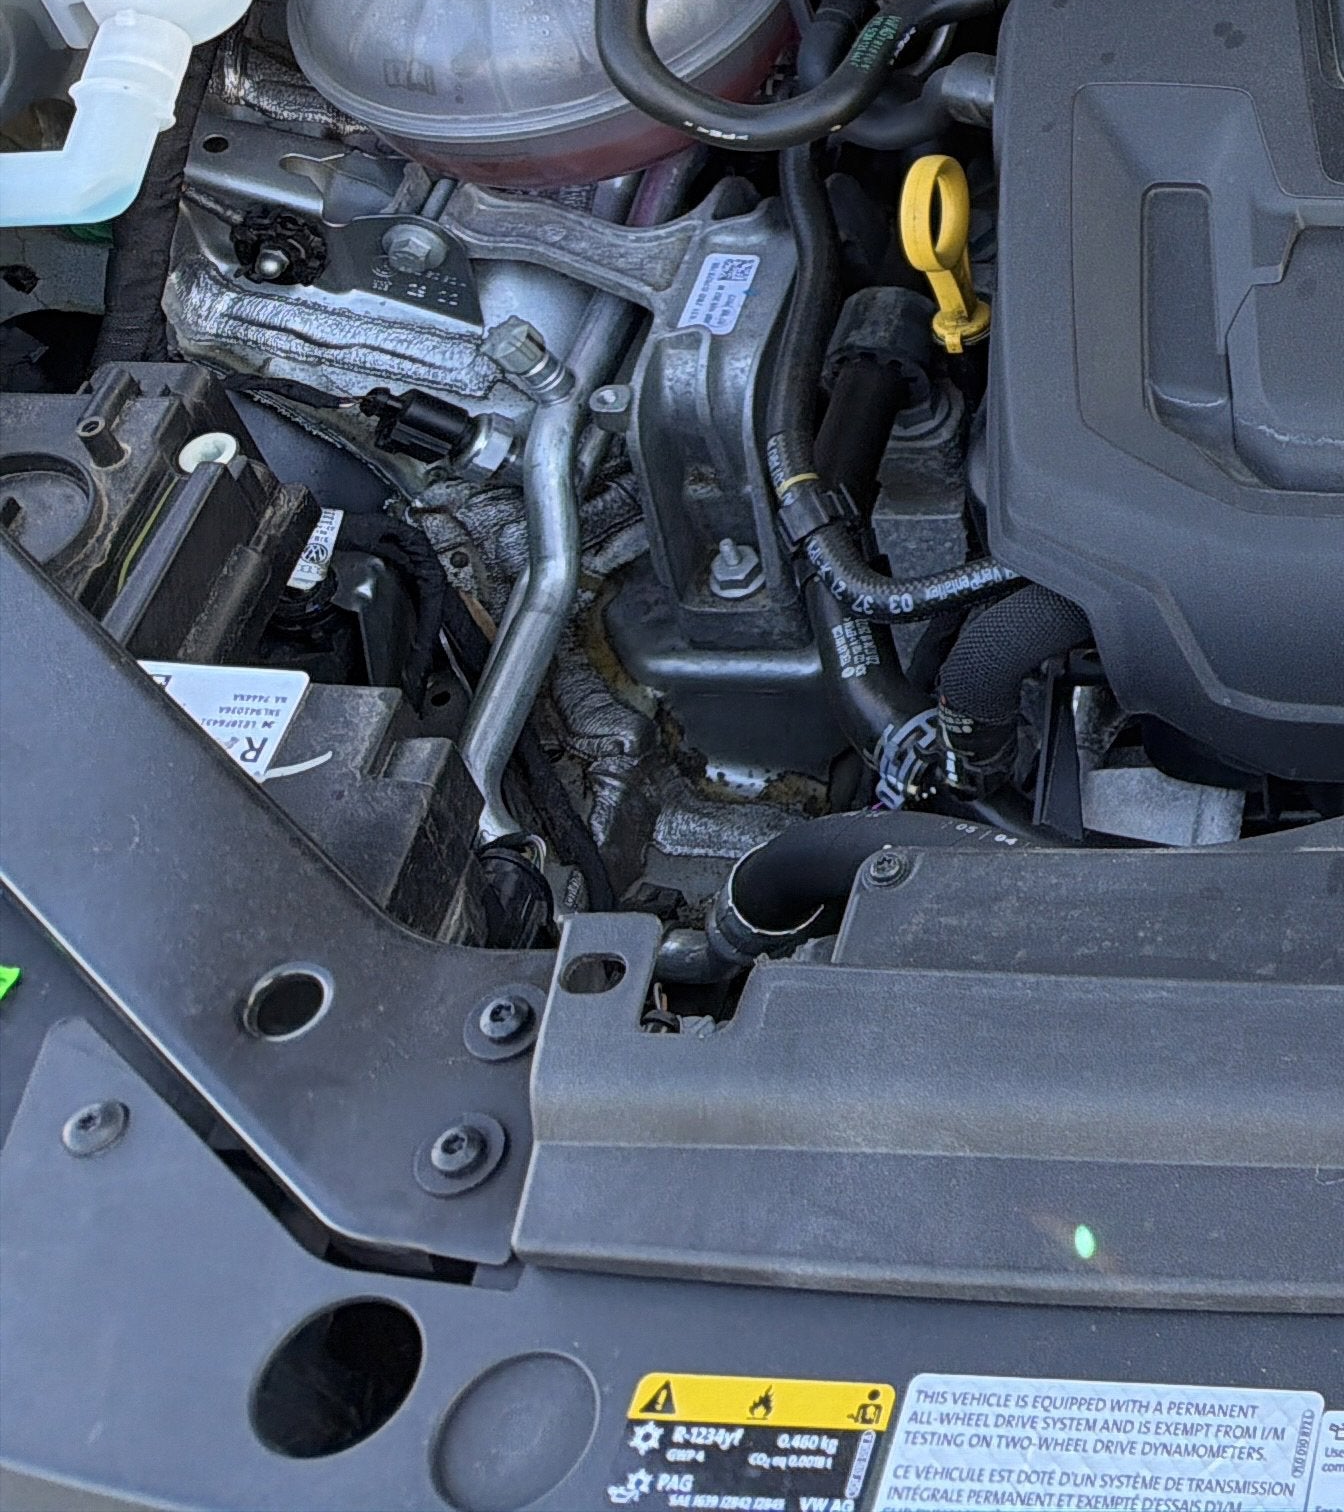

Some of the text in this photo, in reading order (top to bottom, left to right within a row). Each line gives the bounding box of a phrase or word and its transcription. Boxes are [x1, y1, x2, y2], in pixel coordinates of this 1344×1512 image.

[851, 594, 874, 615] 37
[888, 592, 914, 614] 03
[240, 736, 268, 763] R
[915, 1389, 1259, 1419] THIS VEHICLE IS EQUIPPED WITH A PERMANENT
[672, 1425, 744, 1450] R-1234yf
[907, 1410, 1286, 1441] ALL-WHEEL DRIVE SYSTEM AND IS EXEMPT FROM I/M
[666, 1449, 704, 1462] GWP 4
[904, 1430, 1267, 1462] TESTING ON TWO-WHEEL DRIVE DYNAMOMETERS.
[1324, 1447, 1344, 1459] Use
[657, 1473, 694, 1491] PAG
[893, 1461, 1296, 1497] CE VÉHICULE EST DOTÉ D'UN SYSTÈME DE TRANSMISSION
[800, 1496, 855, 1512] VW AG
[887, 1483, 963, 1503] INTÉGRALE
[967, 1489, 1056, 1506] PERMANENT
[1057, 1493, 1074, 1508] ET
[1077, 1492, 1139, 1510] EXEMPTÉ
